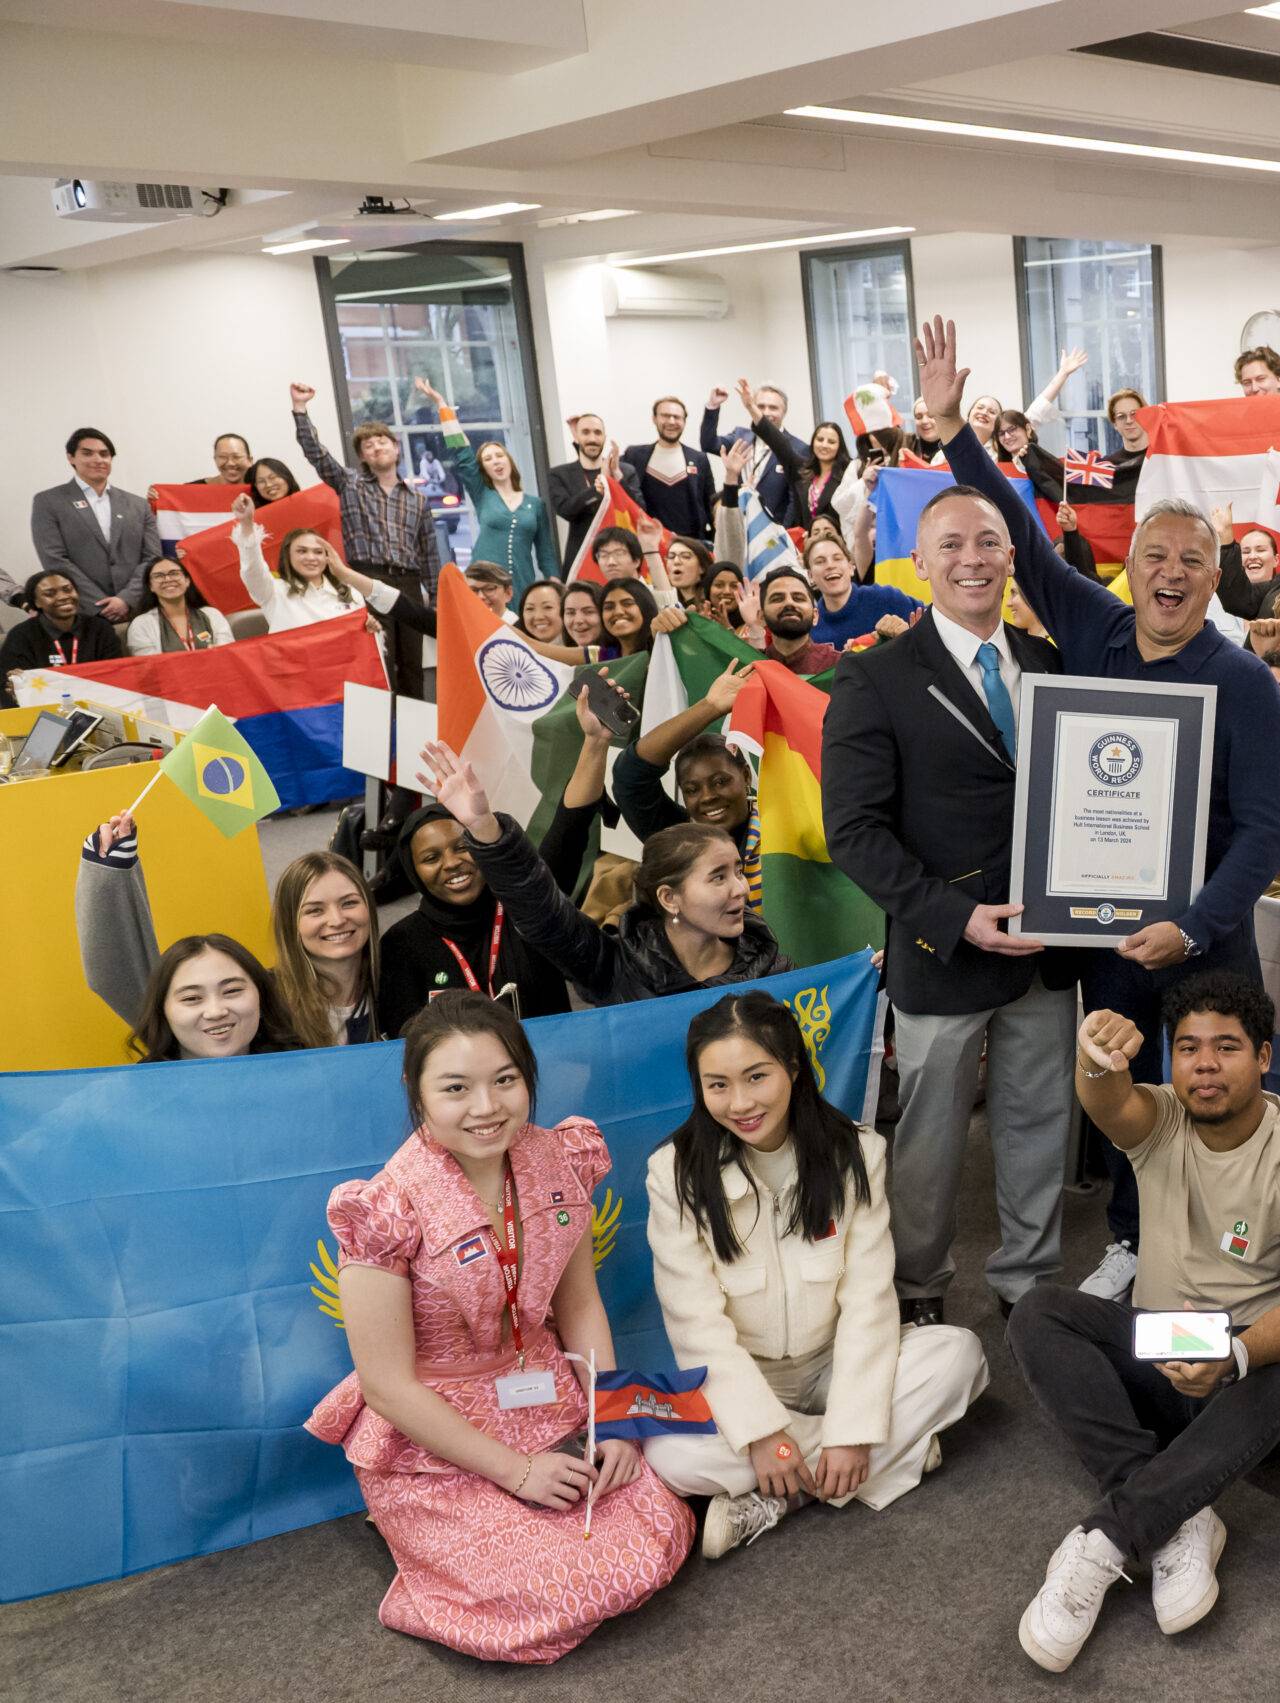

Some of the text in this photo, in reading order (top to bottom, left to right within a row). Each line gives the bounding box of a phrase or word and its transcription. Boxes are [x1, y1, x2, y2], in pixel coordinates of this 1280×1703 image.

[1097, 736, 1136, 751] GUINNESS
[1092, 755, 1140, 784] WORLD RECORDS
[1087, 789, 1141, 799] CERTIFICATE
[558, 1213, 568, 1223] 36
[506, 1220, 516, 1250] VISITOR
[502, 1264, 514, 1292] VISITOR
[511, 1302, 519, 1329] VISITOR
